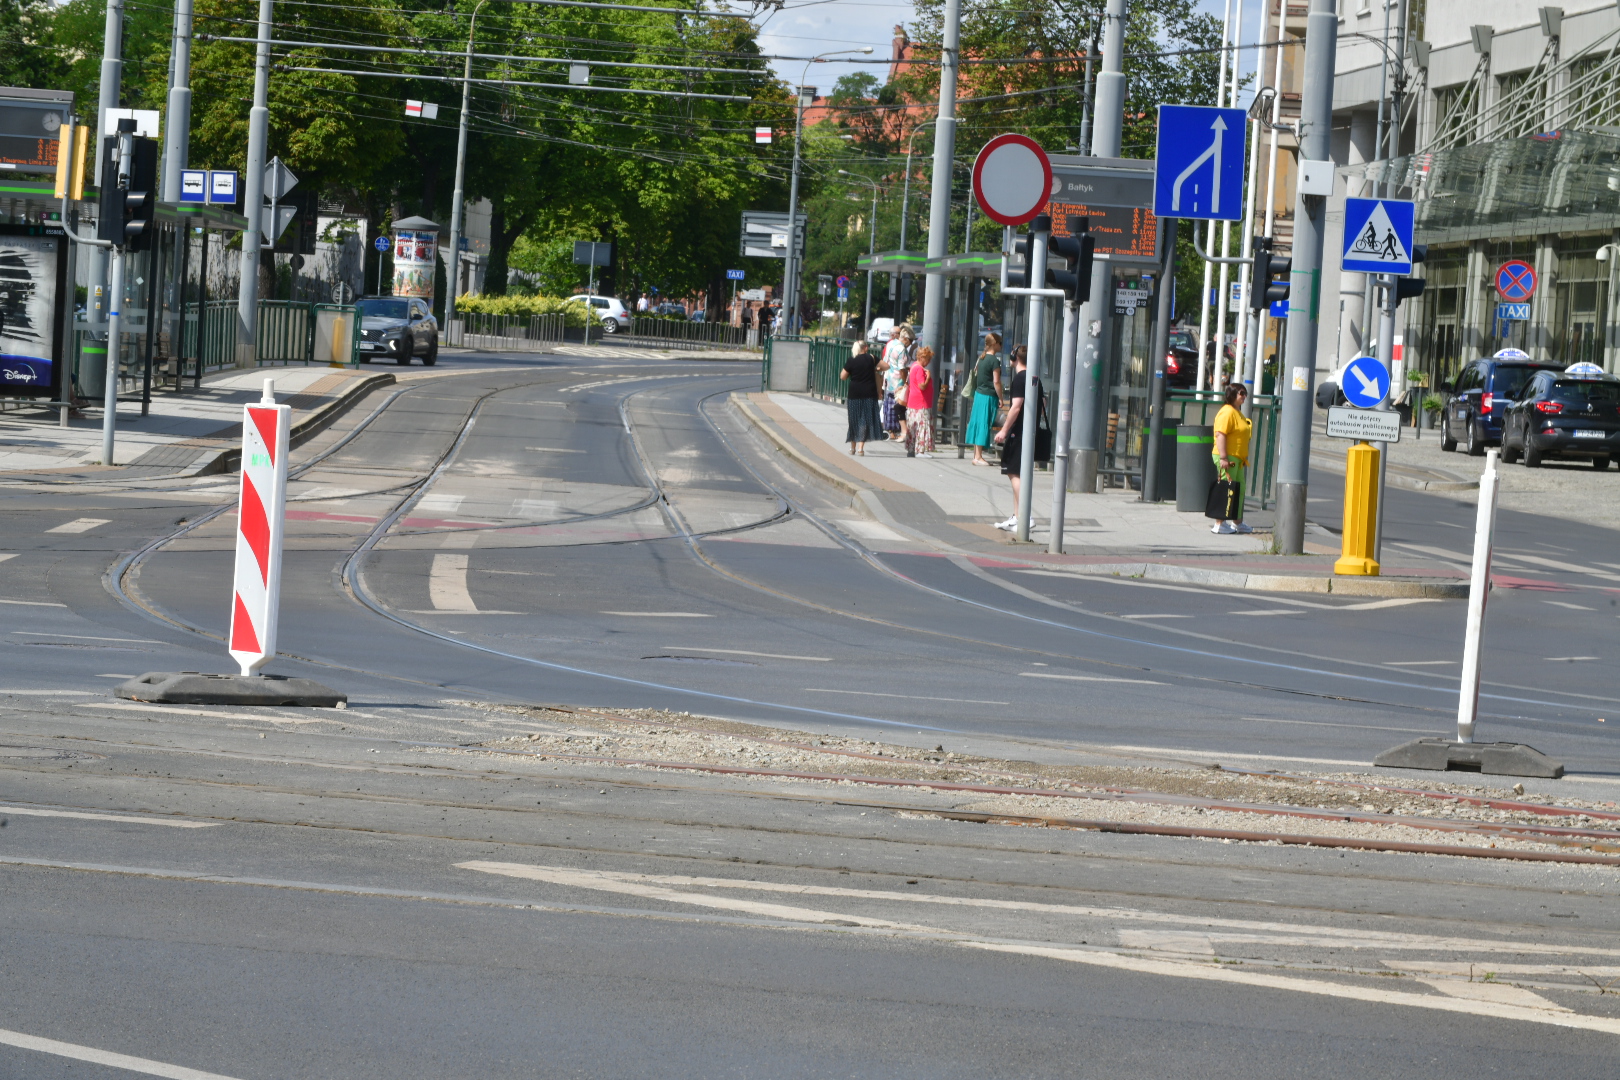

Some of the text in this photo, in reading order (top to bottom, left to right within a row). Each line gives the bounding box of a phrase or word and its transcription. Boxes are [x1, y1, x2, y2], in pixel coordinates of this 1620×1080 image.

[1068, 183, 1094, 193] Bałtyk
[1500, 304, 1529, 318] TAXI
[3, 369, 38, 383] Disney+
[1359, 414, 1382, 423] dotyczy
[1329, 420, 1398, 432] autobusów publicznego
[1362, 430, 1396, 439] zbiorowego
